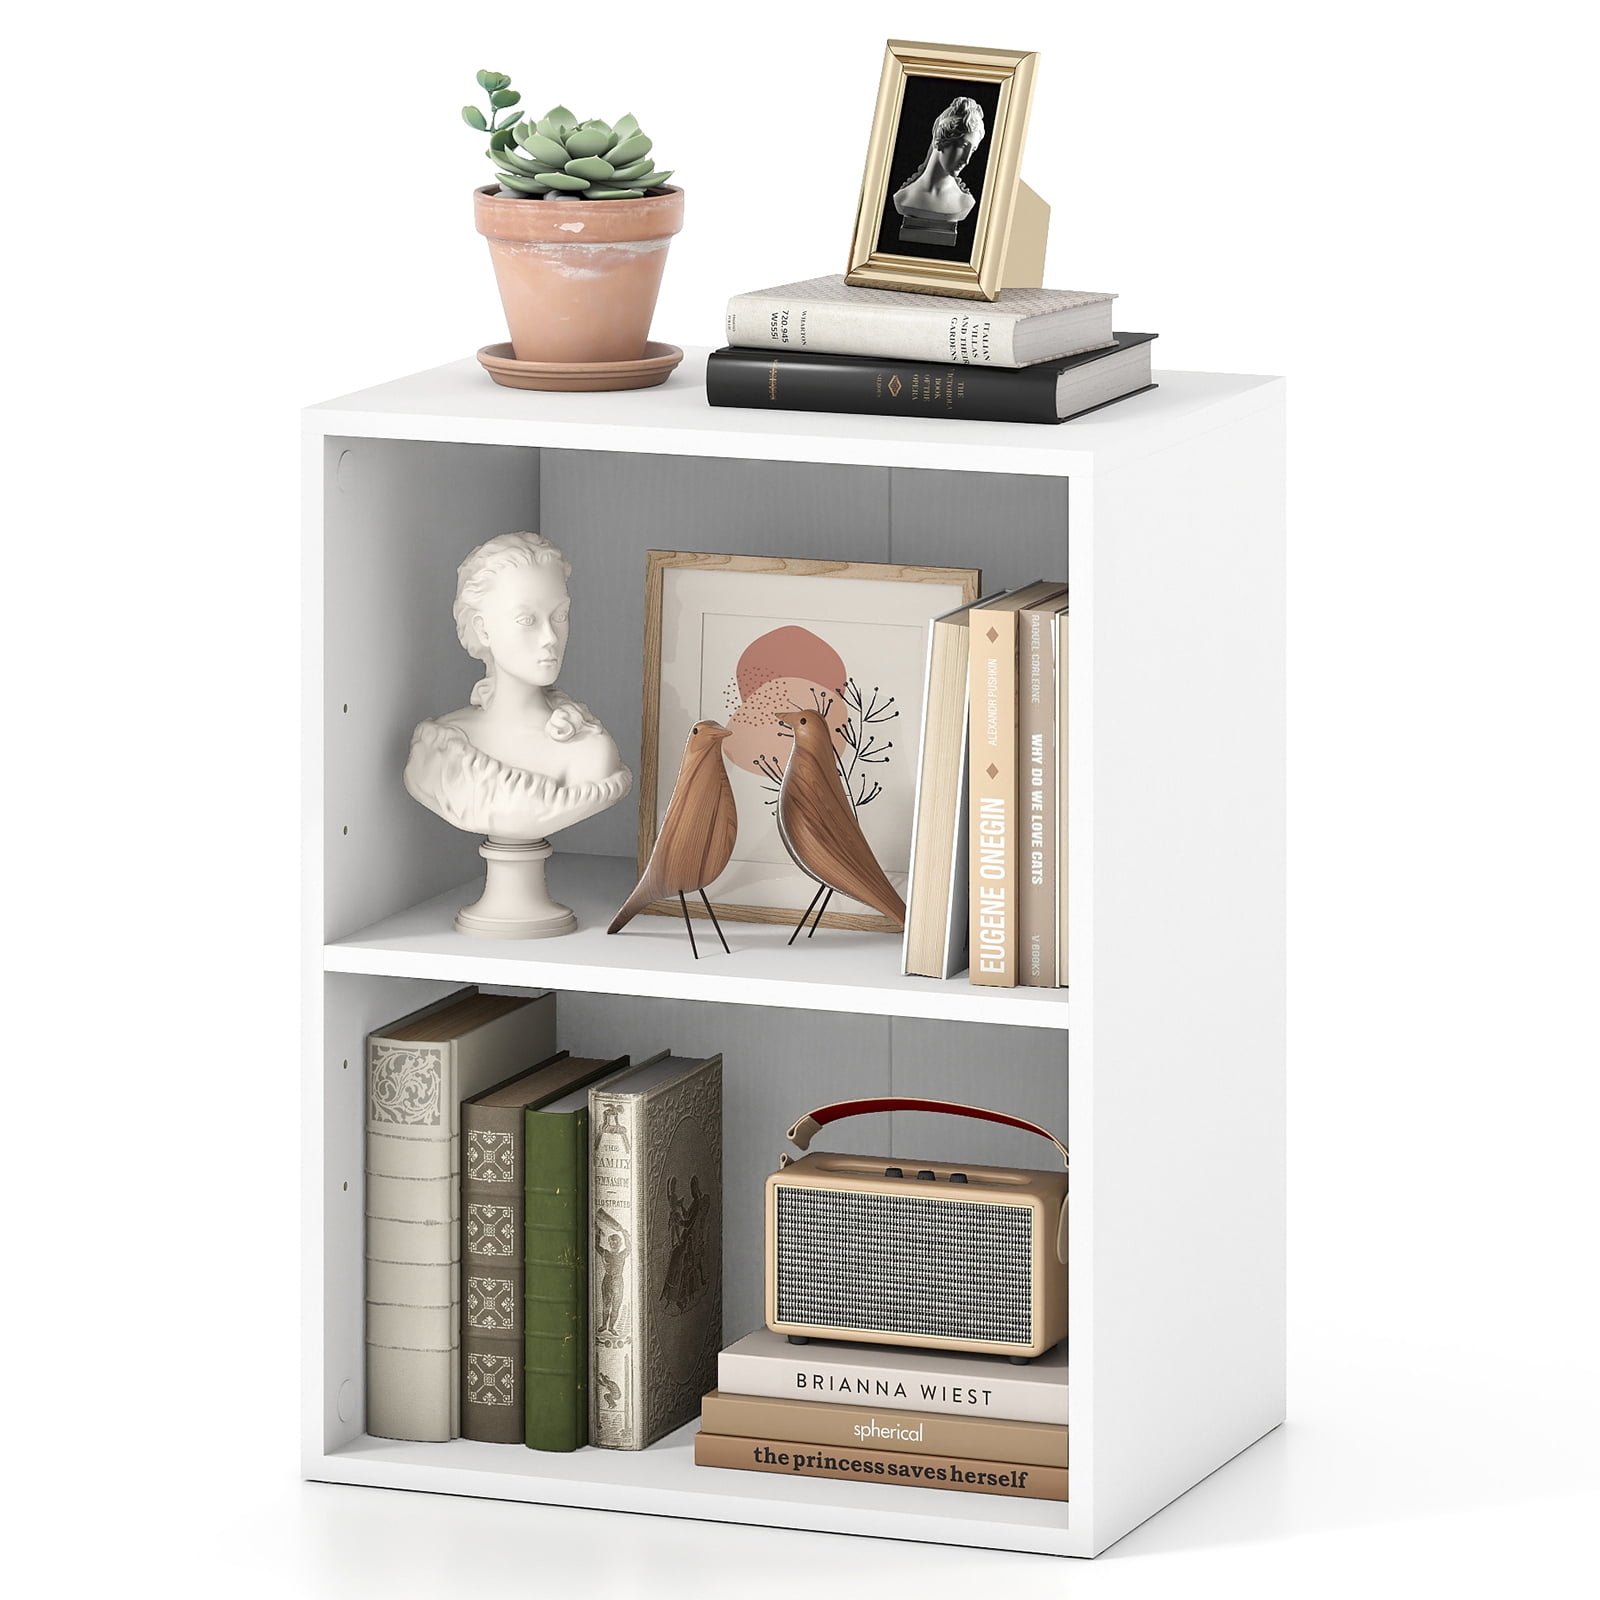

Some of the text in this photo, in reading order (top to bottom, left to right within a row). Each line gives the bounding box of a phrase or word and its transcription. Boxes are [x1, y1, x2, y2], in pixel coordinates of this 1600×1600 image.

[780, 309, 790, 344] 720.945
[800, 310, 808, 346] WHARTON
[949, 317, 958, 361] GARDENS
[961, 315, 969, 335] AND
[971, 324, 979, 358] VILLAS
[982, 322, 991, 361] ITALIAN
[1031, 654, 1041, 704] CORLEONE
[987, 658, 999, 746] ALEXANDR PUSHKIN
[1031, 733, 1043, 885] WHY DO WE LOVE CATS
[979, 797, 1005, 974] EUGENE ONEGIN
[796, 1373, 993, 1406] BRIANNA WIEST
[854, 1418, 923, 1442] spherical
[753, 1446, 1029, 1489] the princess saves herself
